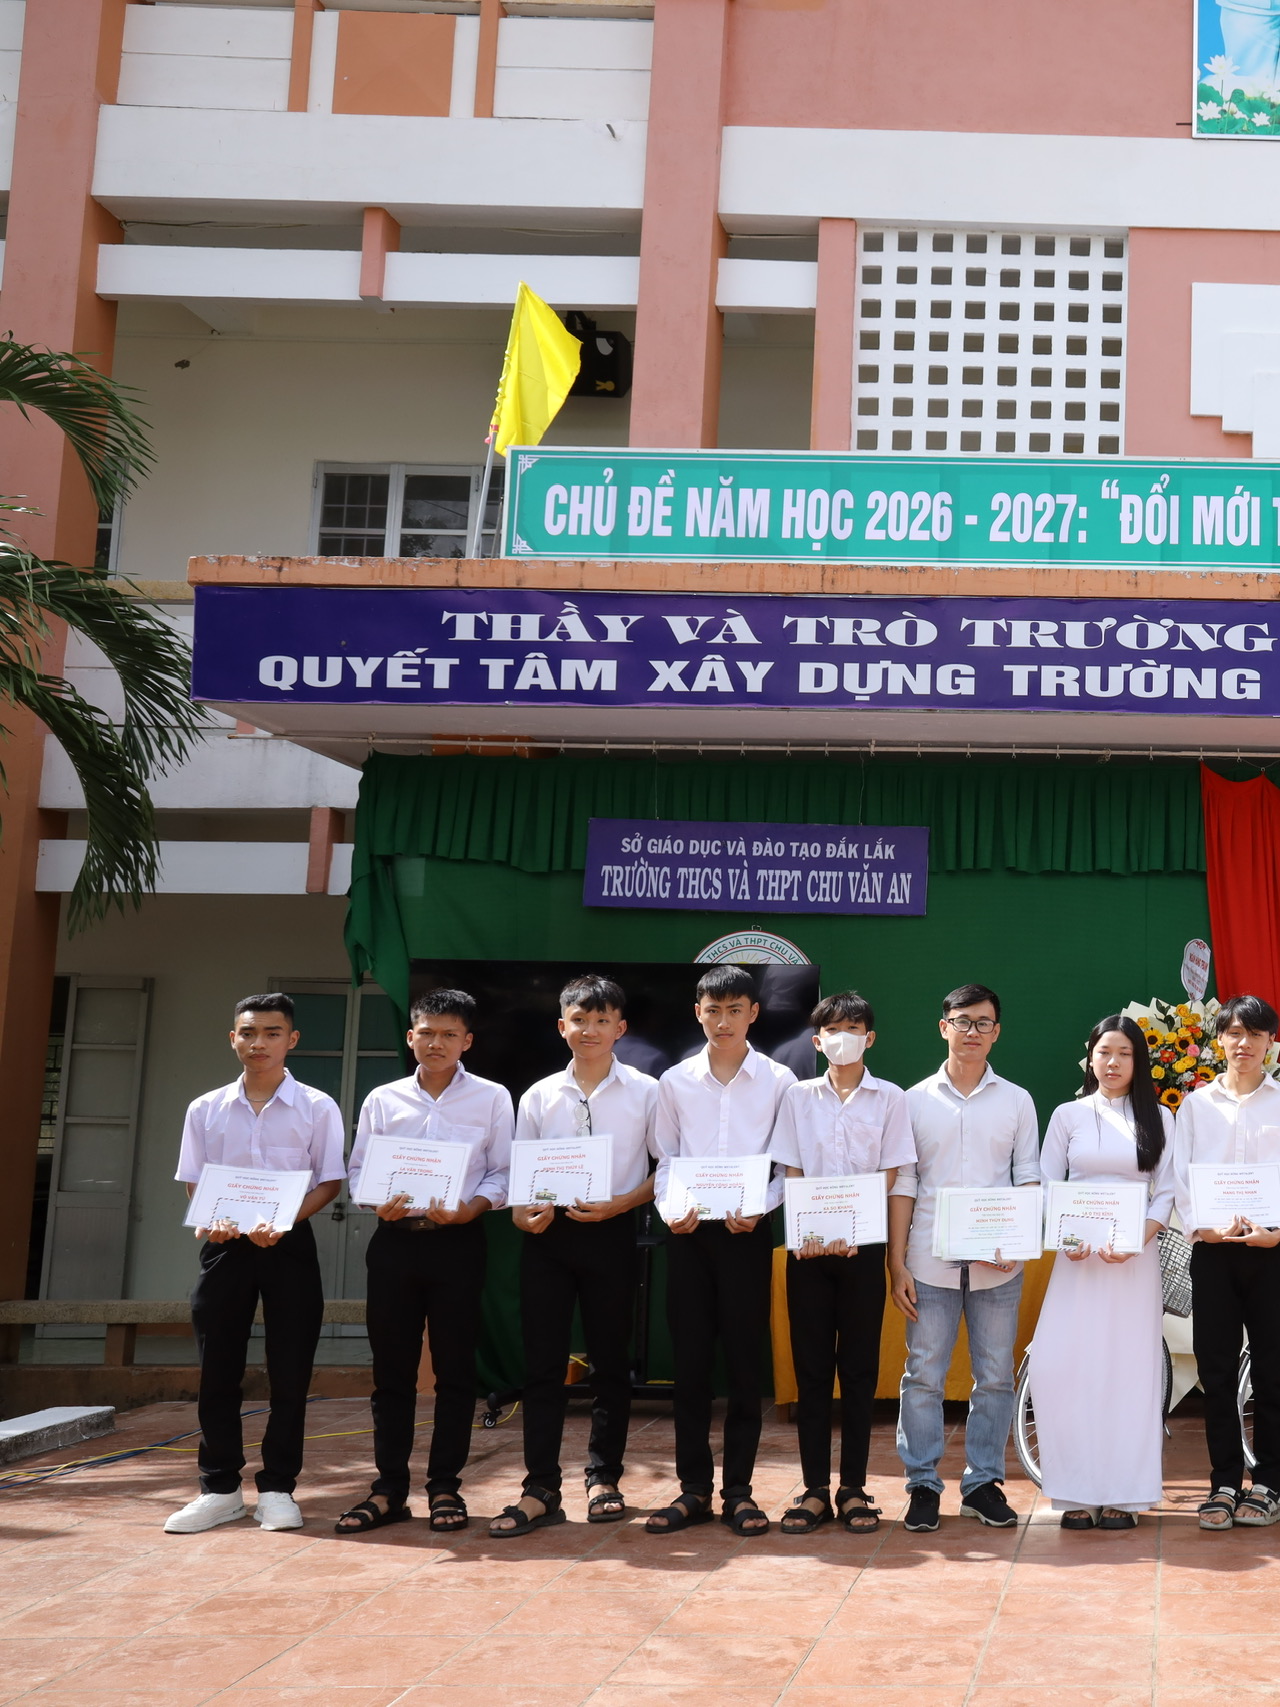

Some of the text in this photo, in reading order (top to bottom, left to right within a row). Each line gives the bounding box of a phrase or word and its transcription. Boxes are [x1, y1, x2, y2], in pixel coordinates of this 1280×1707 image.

[544, 467, 618, 537] CHỦ
[627, 469, 676, 537] ĐỀ
[685, 476, 771, 538] NĂM
[781, 488, 854, 551] HỌC
[864, 490, 953, 542] 2026
[964, 514, 978, 525] -
[989, 492, 1088, 544] 2027:
[1192, 485, 1261, 547] MỚI
[441, 601, 645, 643] THẦY
[661, 608, 763, 645] VÀ
[782, 610, 938, 647] TRÒ
[959, 614, 1278, 653] TRƯỜNG
[258, 647, 460, 691] QUYẾT
[479, 652, 618, 691] TÂM
[647, 654, 775, 693] XÂY
[798, 660, 976, 701] DỰNG
[1003, 659, 1261, 700] TRƯỜNG
[620, 832, 896, 861] SỞ GIÁO DỤC VÀ ĐÀO TẠO ĐẮK LẮK
[600, 856, 912, 905] TRƯỜNG THCS VÀ THPT CHU VĂN AN
[706, 937, 801, 964] THCS VÀ THPT CHU VĂ
